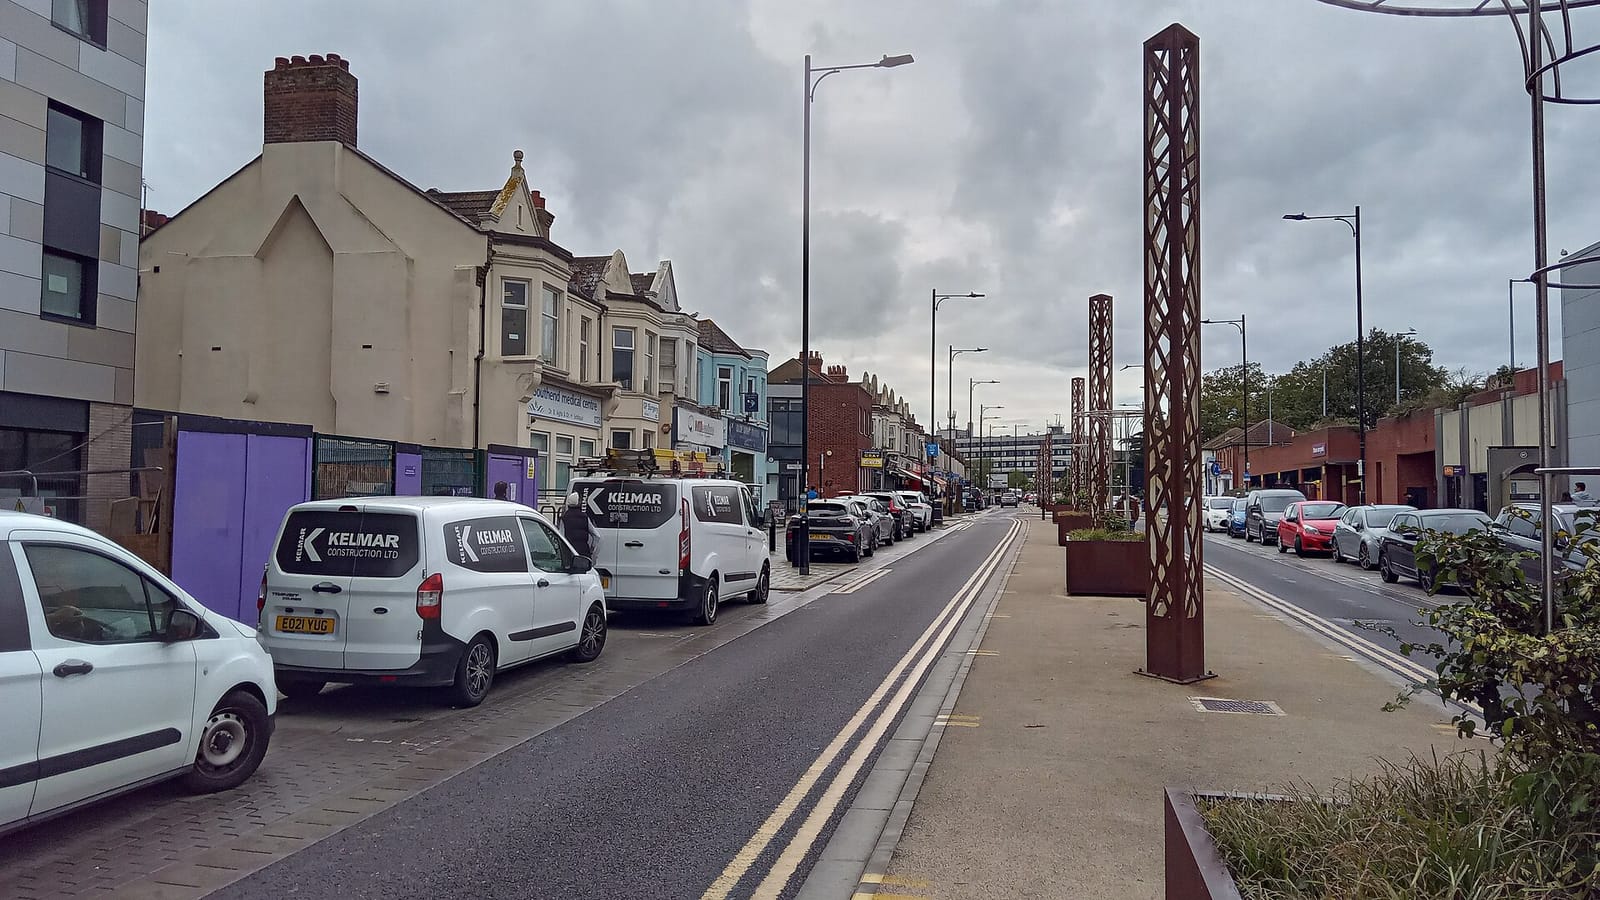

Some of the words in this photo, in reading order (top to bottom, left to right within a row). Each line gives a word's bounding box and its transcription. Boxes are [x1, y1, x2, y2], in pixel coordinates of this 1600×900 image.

[562, 395, 582, 407] medical
[582, 400, 598, 411] centre
[608, 492, 662, 505] KELMAR
[608, 504, 650, 512] CONSTRUCTION
[328, 532, 400, 548] KELMAR
[476, 529, 513, 545] KELMAR
[296, 528, 306, 562] KELMAR
[327, 548, 382, 559] CONSTRUCTION
[383, 550, 398, 559] LTD
[307, 619, 328, 631] YUG
